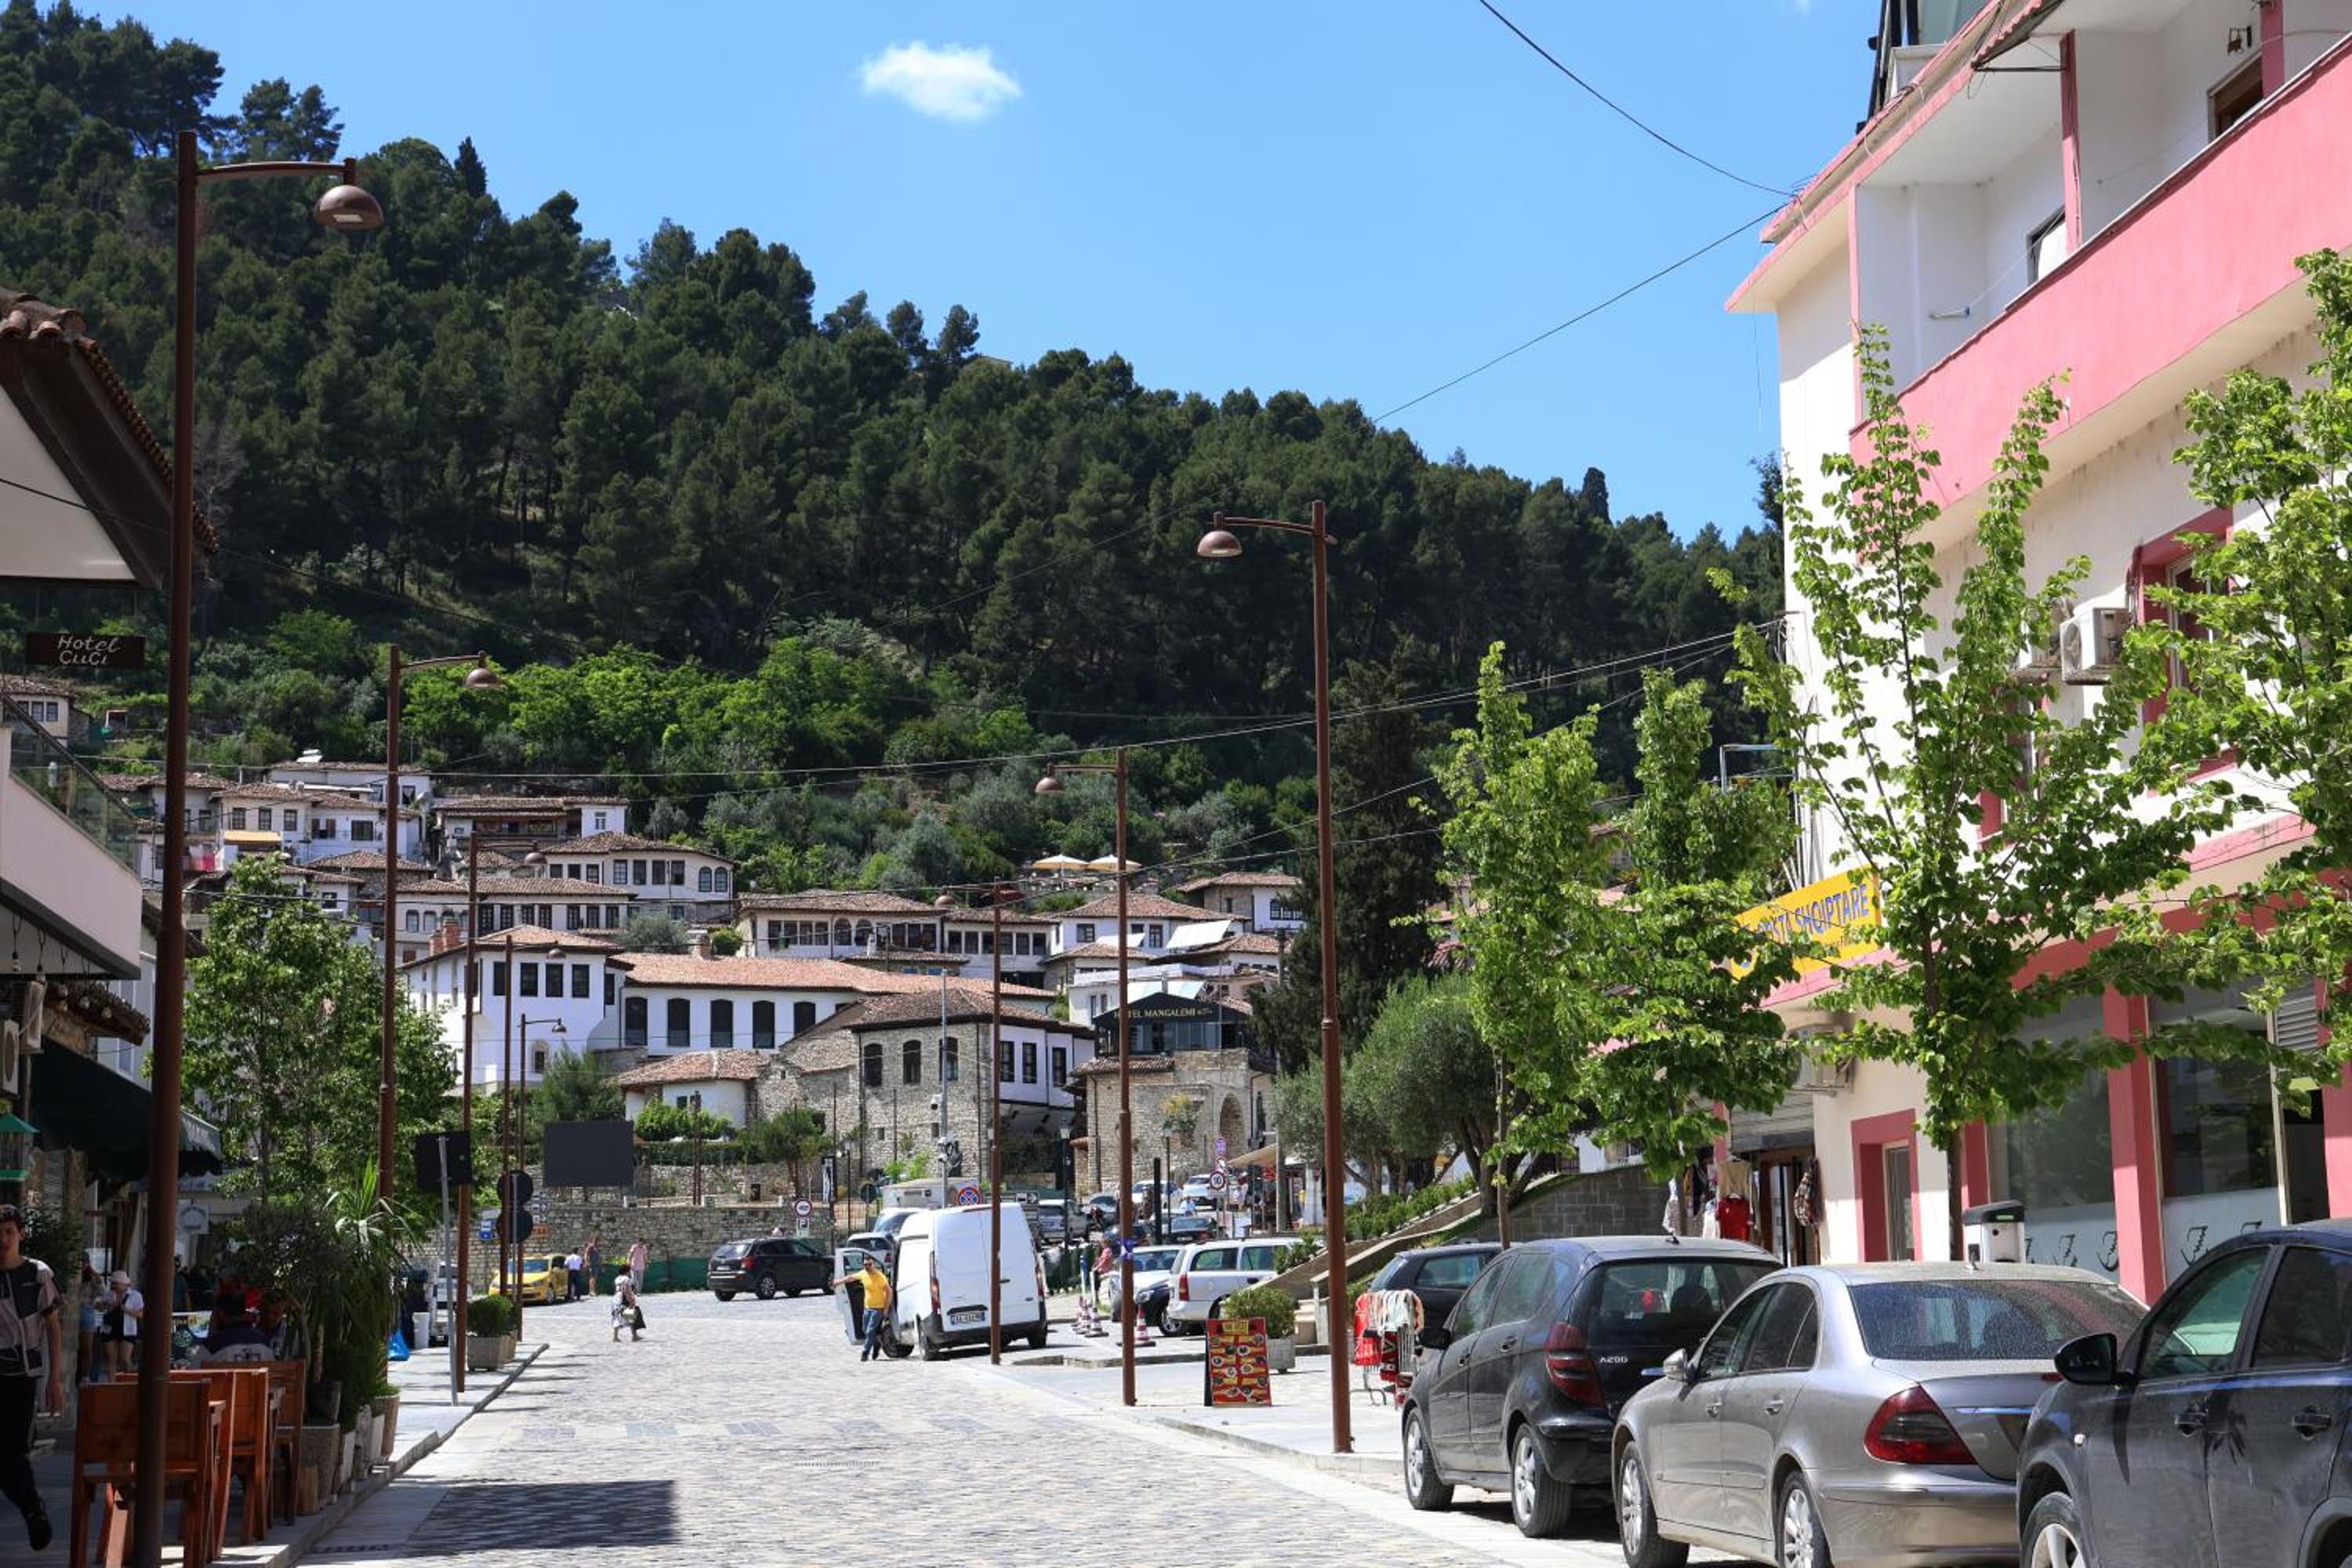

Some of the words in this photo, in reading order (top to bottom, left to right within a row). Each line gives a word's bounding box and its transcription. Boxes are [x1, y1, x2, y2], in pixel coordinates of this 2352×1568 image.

[57, 634, 121, 652] Hotel
[1113, 1010, 1142, 1018] HTEL
[1144, 1007, 1196, 1017] MANGALEMI
